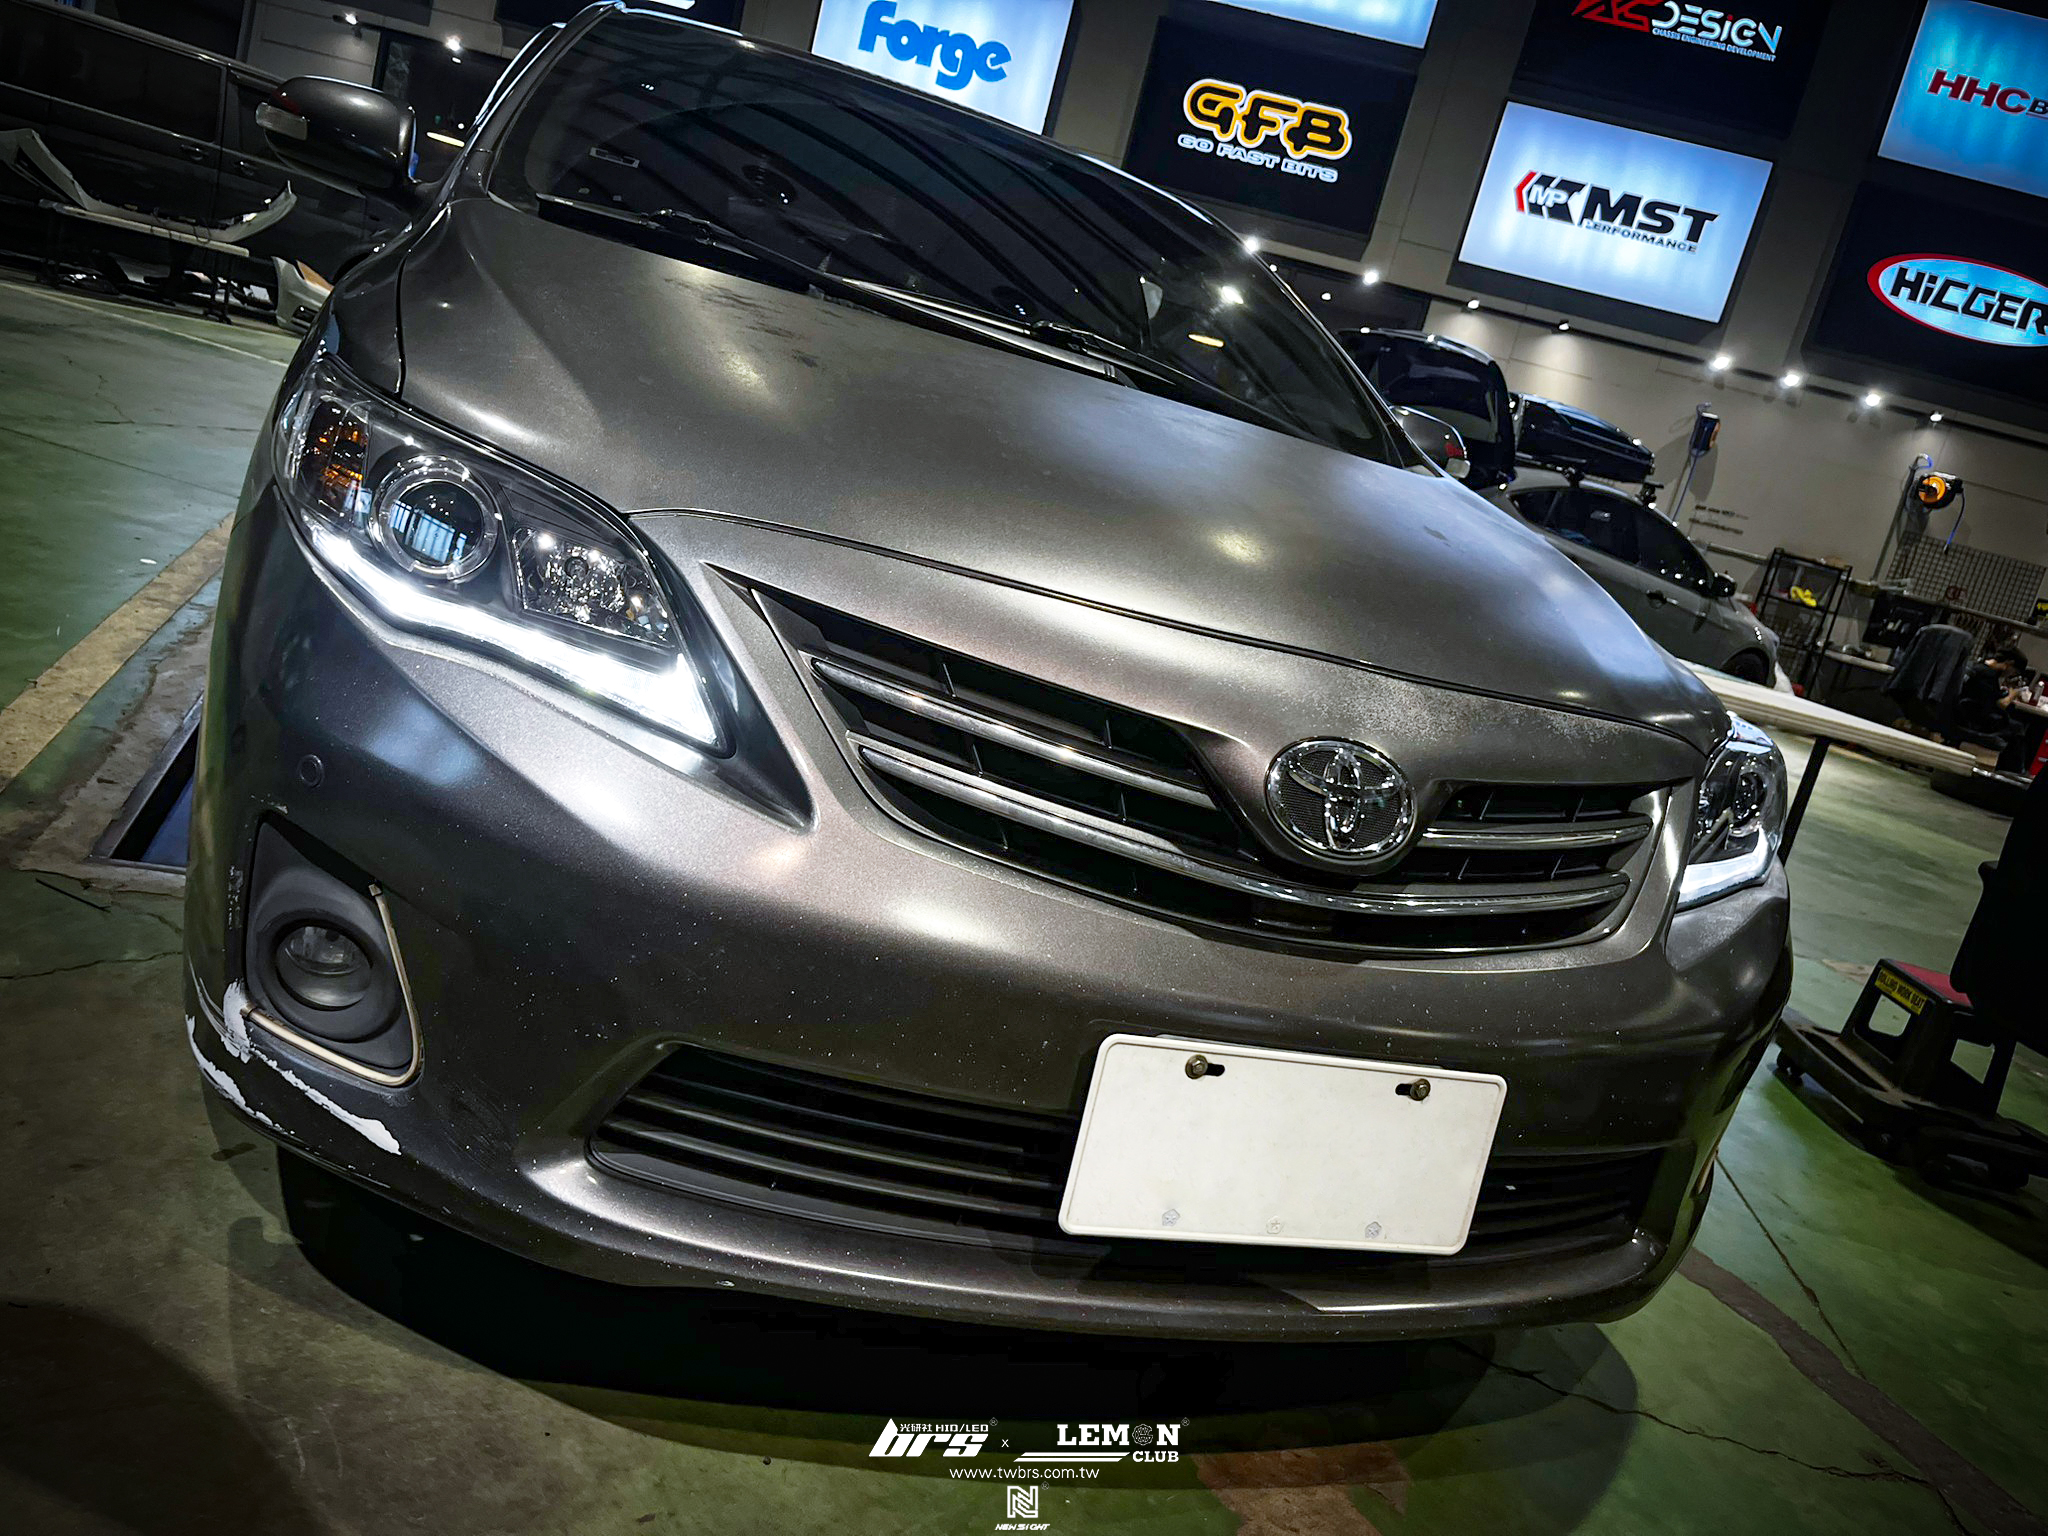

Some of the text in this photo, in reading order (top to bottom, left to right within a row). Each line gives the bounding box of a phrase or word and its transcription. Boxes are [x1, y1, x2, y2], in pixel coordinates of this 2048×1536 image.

[1726, 43, 1776, 62] DEVELOPMENT
[1927, 68, 2031, 114] HHC
[1183, 78, 1353, 160] GFB
[1177, 134, 1339, 183] GO FAST BITS
[1578, 186, 1720, 244] MST
